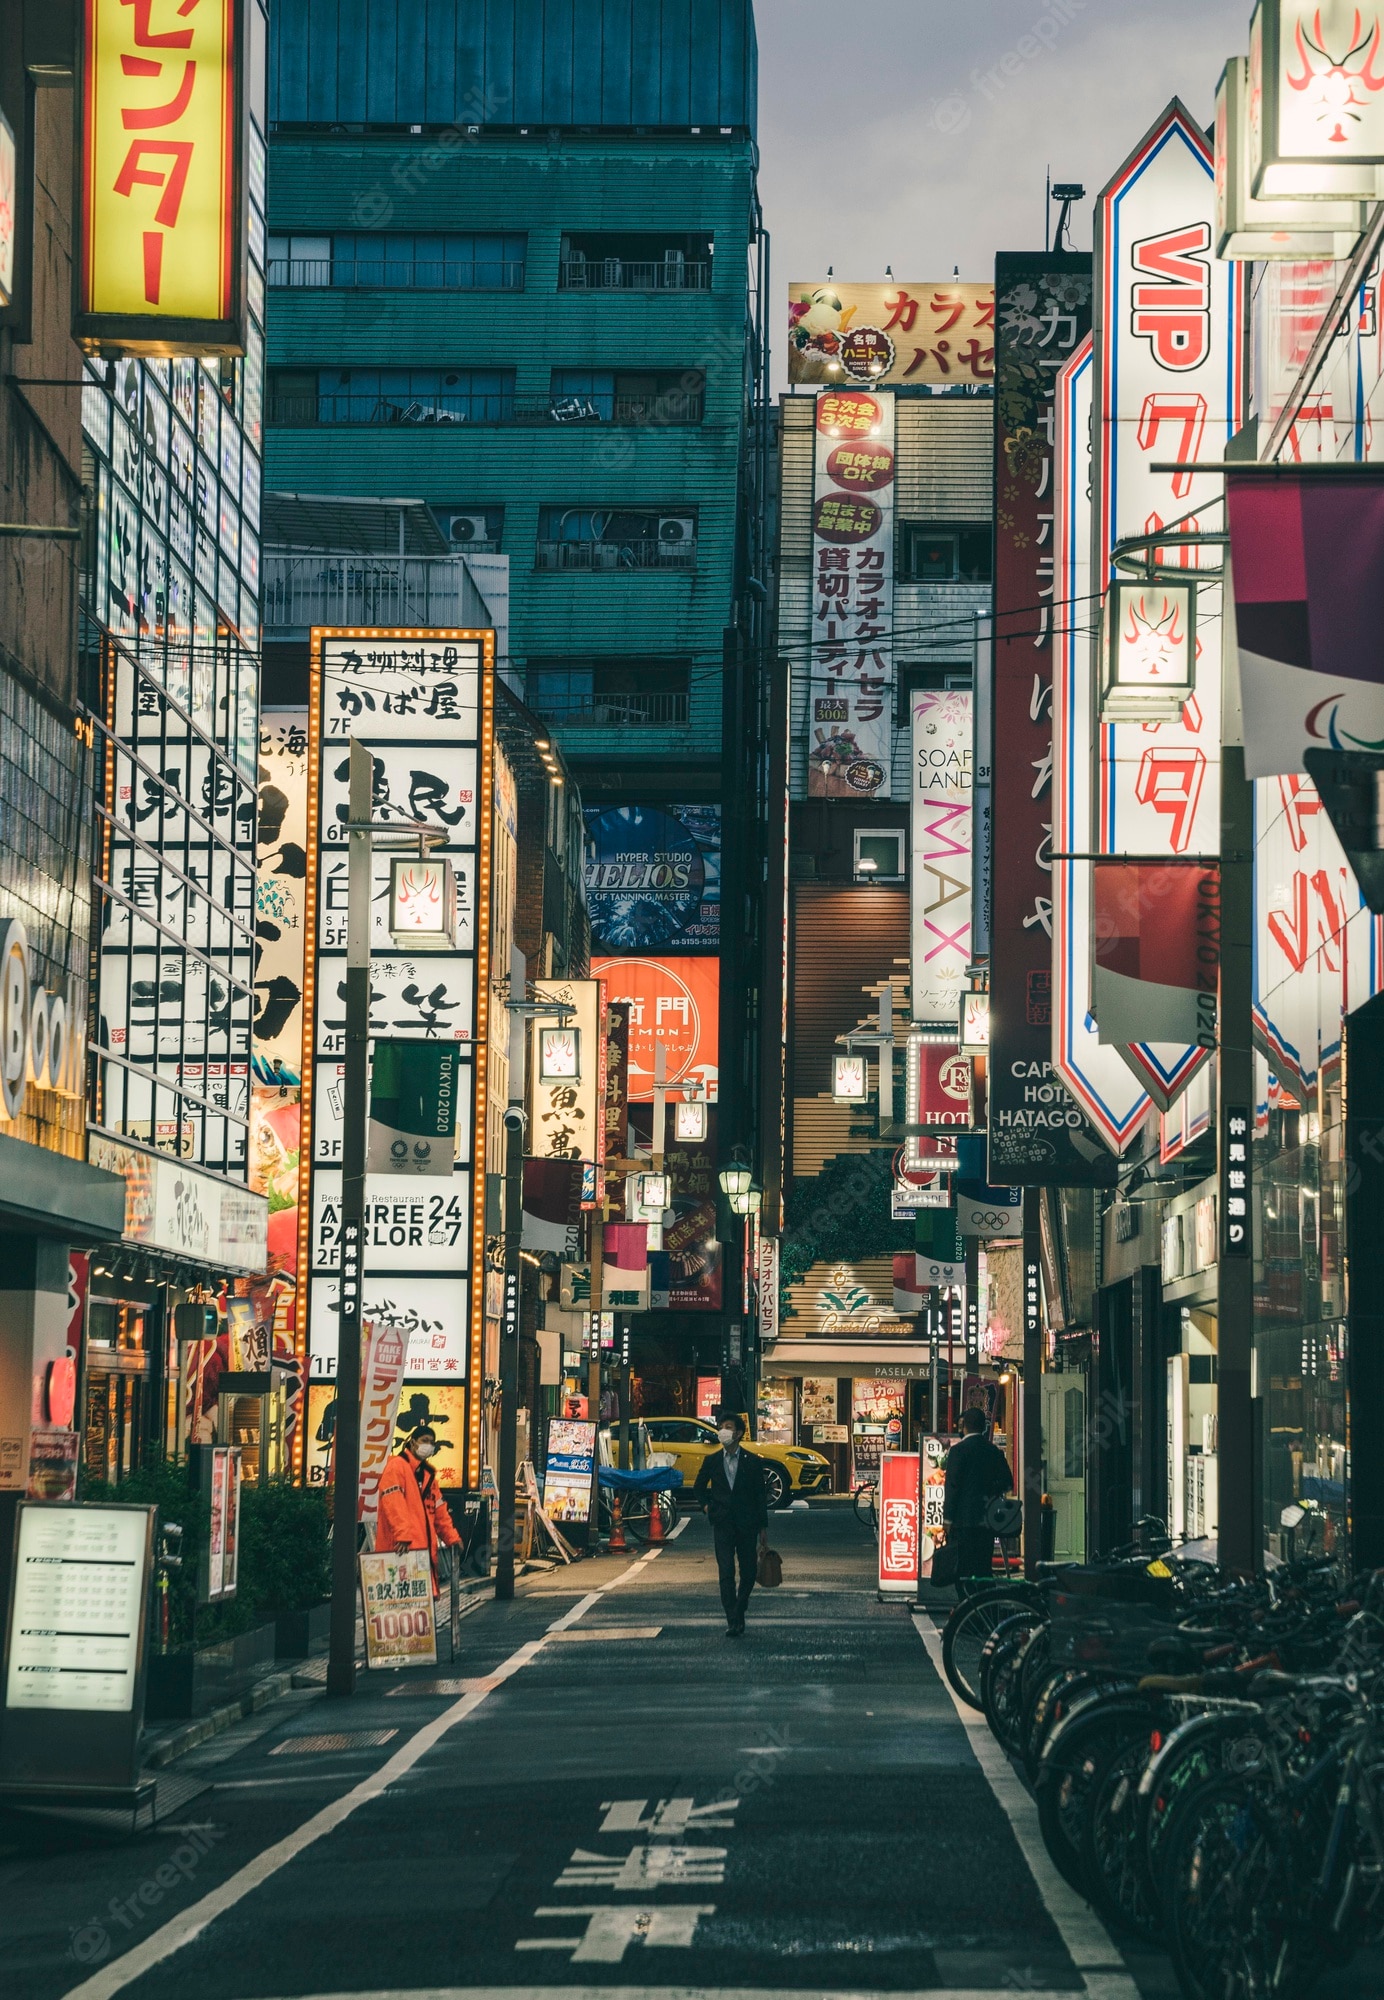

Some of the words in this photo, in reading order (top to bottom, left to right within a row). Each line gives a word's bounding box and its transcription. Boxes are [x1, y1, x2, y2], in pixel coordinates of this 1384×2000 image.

[1131, 222, 1211, 373] VIP
[853, 334, 877, 345] 名物
[823, 398, 876, 417] 2次会
[820, 412, 872, 431] 3次会
[835, 452, 891, 470] 団体様
[843, 467, 876, 482] OK
[821, 501, 876, 519] 朝まで
[817, 514, 873, 534] 営業中
[815, 547, 852, 696] 貸切パーティー
[853, 547, 887, 722] カラオケパセラ
[336, 682, 461, 720] かば屋
[616, 853, 649, 862] HYPER
[654, 853, 692, 862] STUDIO
[585, 863, 692, 889] HELIOS
[922, 799, 972, 963] MAX
[610, 893, 652, 901] TANNING
[655, 893, 690, 901] MASTER
[439, 1055, 452, 1097] TOKYO
[1011, 1061, 1058, 1078] CAP
[437, 1101, 449, 1132] 2020
[319, 1140, 342, 1156] 3F
[1228, 1117, 1247, 1243] 仲見世通り
[371, 1195, 424, 1203] Restaurant
[317, 1248, 340, 1265] 2F
[341, 1225, 358, 1315] 仲見世通り
[761, 1243, 773, 1331] カラオケパセラ
[1026, 1263, 1038, 1330] 仲見世通り
[505, 1274, 516, 1335] 仲見世通り
[968, 1304, 977, 1356] 仲見世通り
[378, 1344, 401, 1355] TAKE
[379, 1353, 397, 1364] OUT
[875, 1368, 914, 1376] PASELA
[358, 1367, 398, 1521] テイクアウト
[928, 1443, 941, 1452] B1
